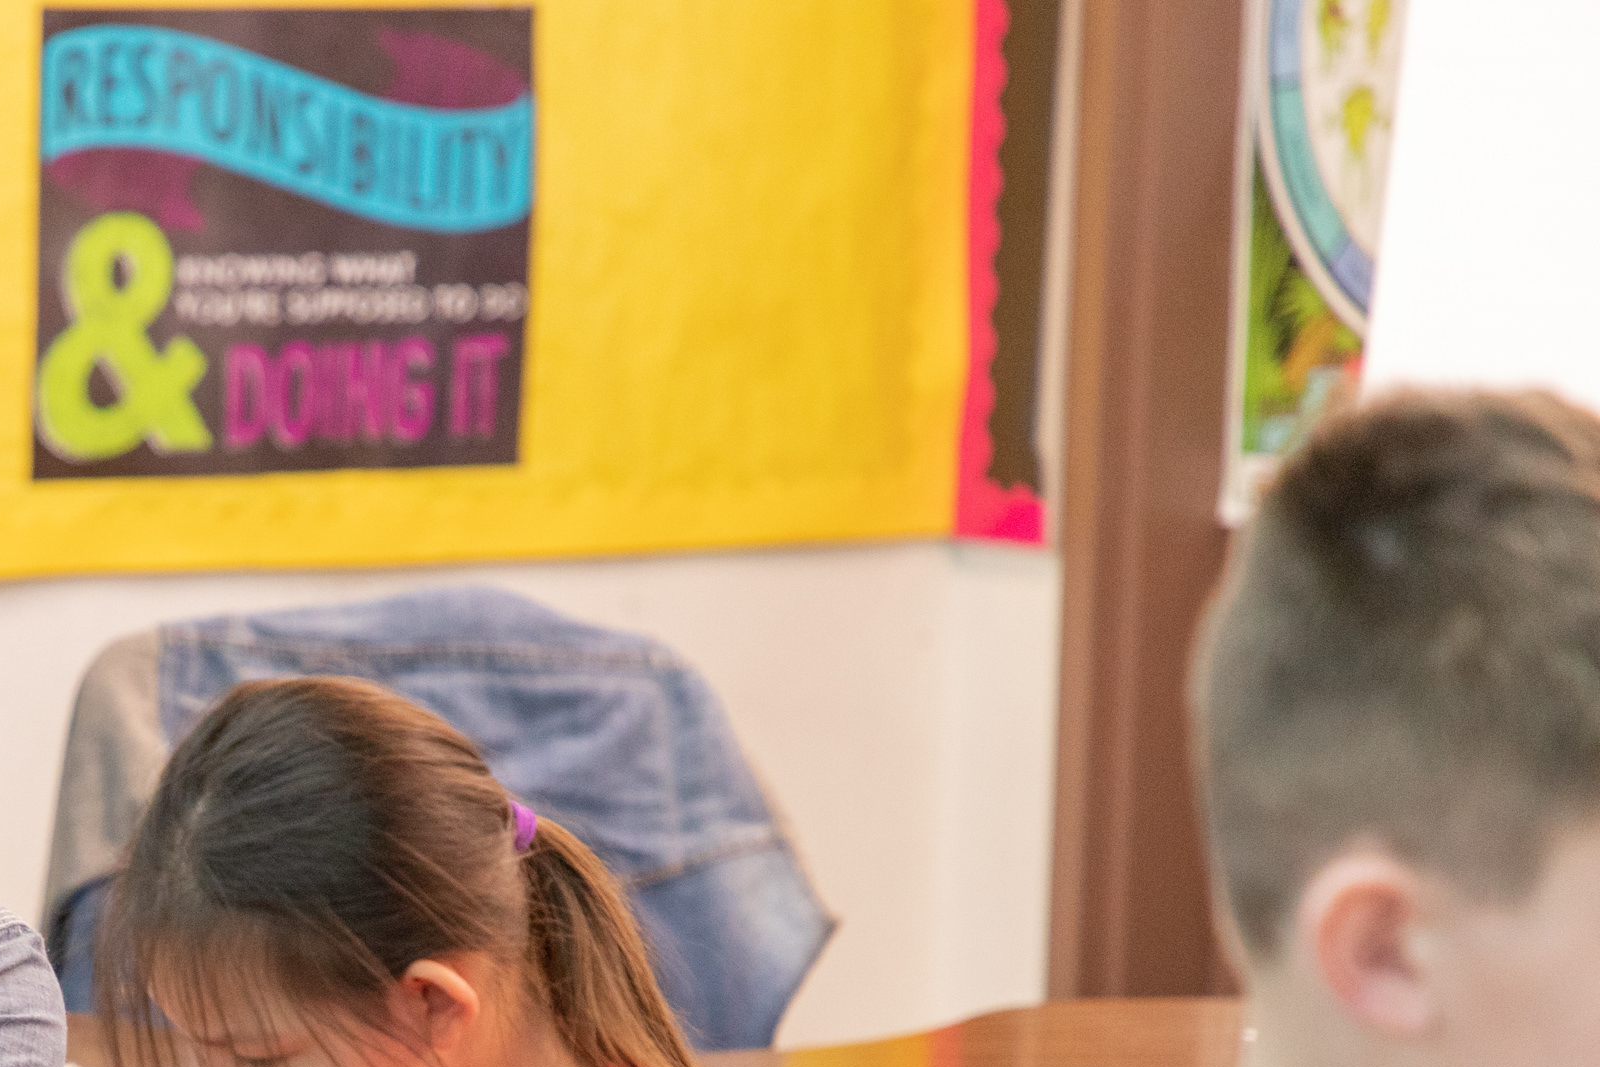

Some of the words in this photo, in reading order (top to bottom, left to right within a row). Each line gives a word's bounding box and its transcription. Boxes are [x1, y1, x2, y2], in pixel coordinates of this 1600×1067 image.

[54, 38, 529, 213] RESPONSIBILITY
[177, 253, 326, 286] KNOWING
[330, 251, 415, 284] WHAT
[286, 286, 430, 324] SUPPOSED
[434, 284, 478, 323] TO
[481, 282, 528, 321] DO
[37, 211, 213, 460] &
[224, 337, 435, 446] DOING
[450, 333, 511, 438] IT
